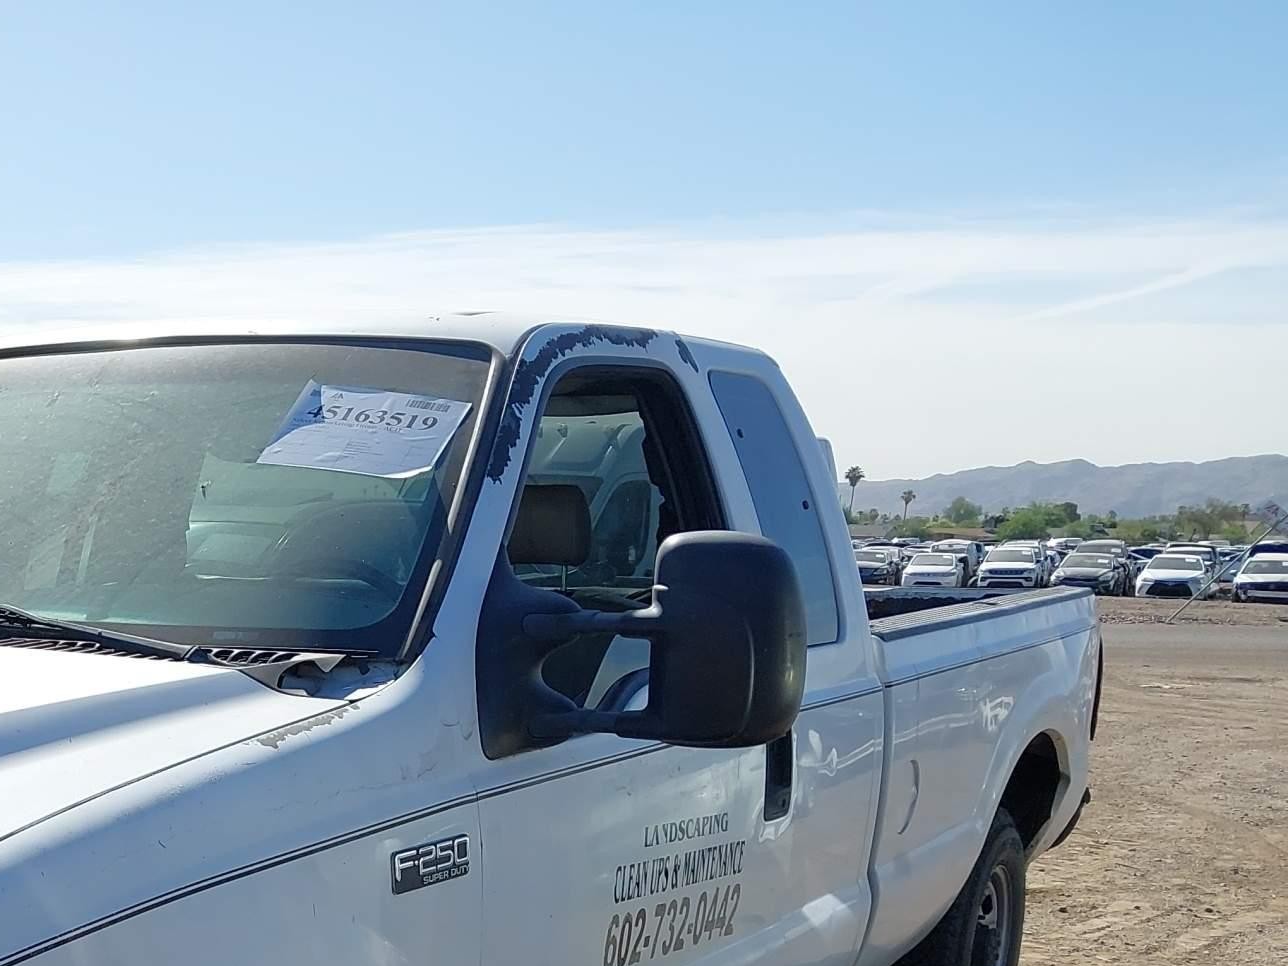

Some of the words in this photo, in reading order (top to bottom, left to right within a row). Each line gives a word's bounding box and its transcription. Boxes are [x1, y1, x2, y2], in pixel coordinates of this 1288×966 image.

[306, 403, 440, 432] 45163519
[643, 812, 729, 848] LANDSCAPING
[423, 871, 450, 885] SUPER
[450, 864, 470, 877] DUTY
[614, 861, 650, 904] CLEAN
[650, 855, 670, 895] UPS
[671, 854, 681, 890] &
[682, 840, 746, 888] MAINTENANCE
